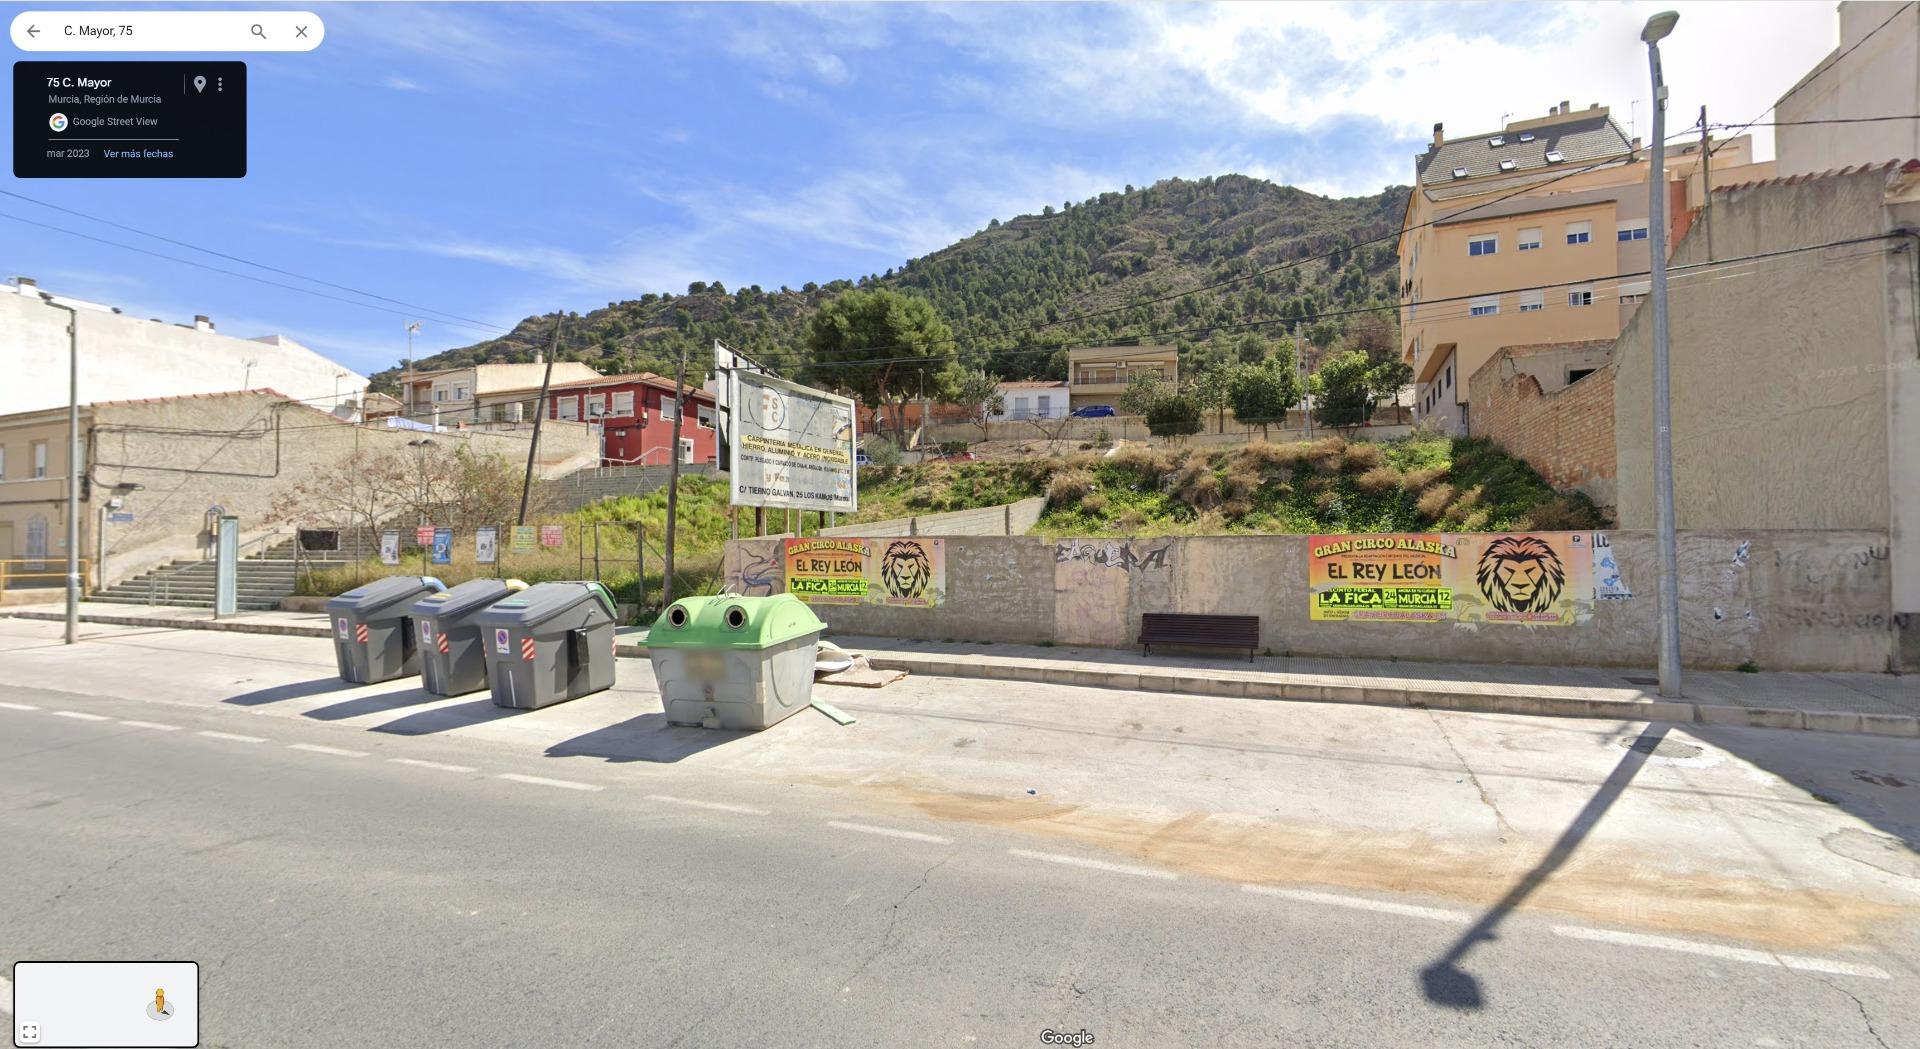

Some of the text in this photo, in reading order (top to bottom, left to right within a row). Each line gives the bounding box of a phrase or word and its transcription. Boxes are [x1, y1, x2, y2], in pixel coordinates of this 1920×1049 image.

[748, 486, 771, 496] TIERNO
[796, 491, 803, 499] 25
[804, 491, 815, 499] LOS
[788, 540, 871, 557] GRAN CIRCO ALASKA
[1314, 539, 1351, 558] GRAN
[1354, 538, 1395, 550] CIRCO
[1397, 538, 1457, 559] ALASKA
[796, 559, 809, 572] EL
[834, 557, 862, 573] LEÓN
[1327, 560, 1442, 581] EL REY LEÓN
[791, 581, 828, 591] LA FICA
[837, 583, 859, 592] MURCIA
[1320, 592, 1382, 604] LA FICA
[1385, 591, 1396, 600] 24
[1398, 593, 1437, 604] MURCIA
[1439, 591, 1450, 601] 12
